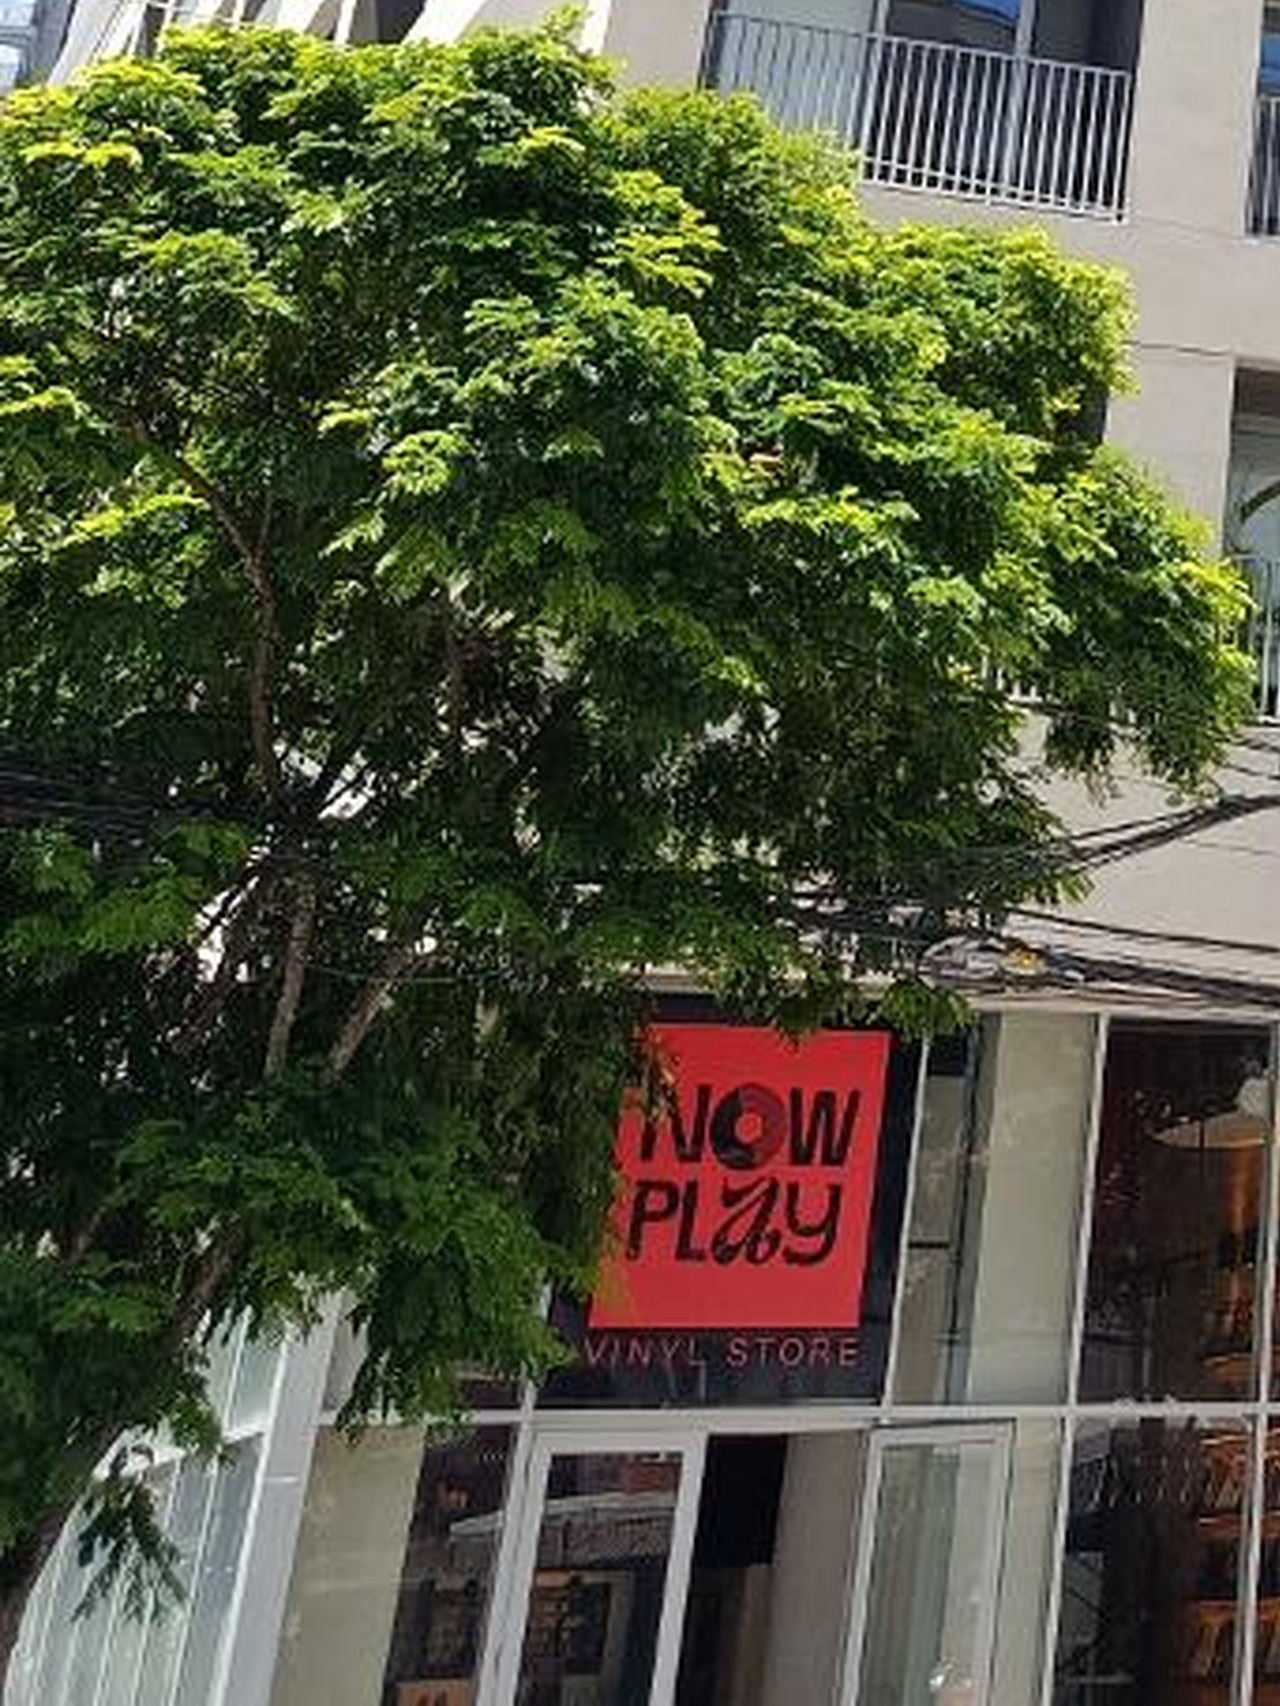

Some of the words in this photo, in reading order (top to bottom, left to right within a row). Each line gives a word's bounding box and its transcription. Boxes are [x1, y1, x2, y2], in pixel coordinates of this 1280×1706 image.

[640, 1083, 861, 1171] NOW
[585, 1338, 705, 1367] VINYL
[726, 1337, 858, 1367] STORE
